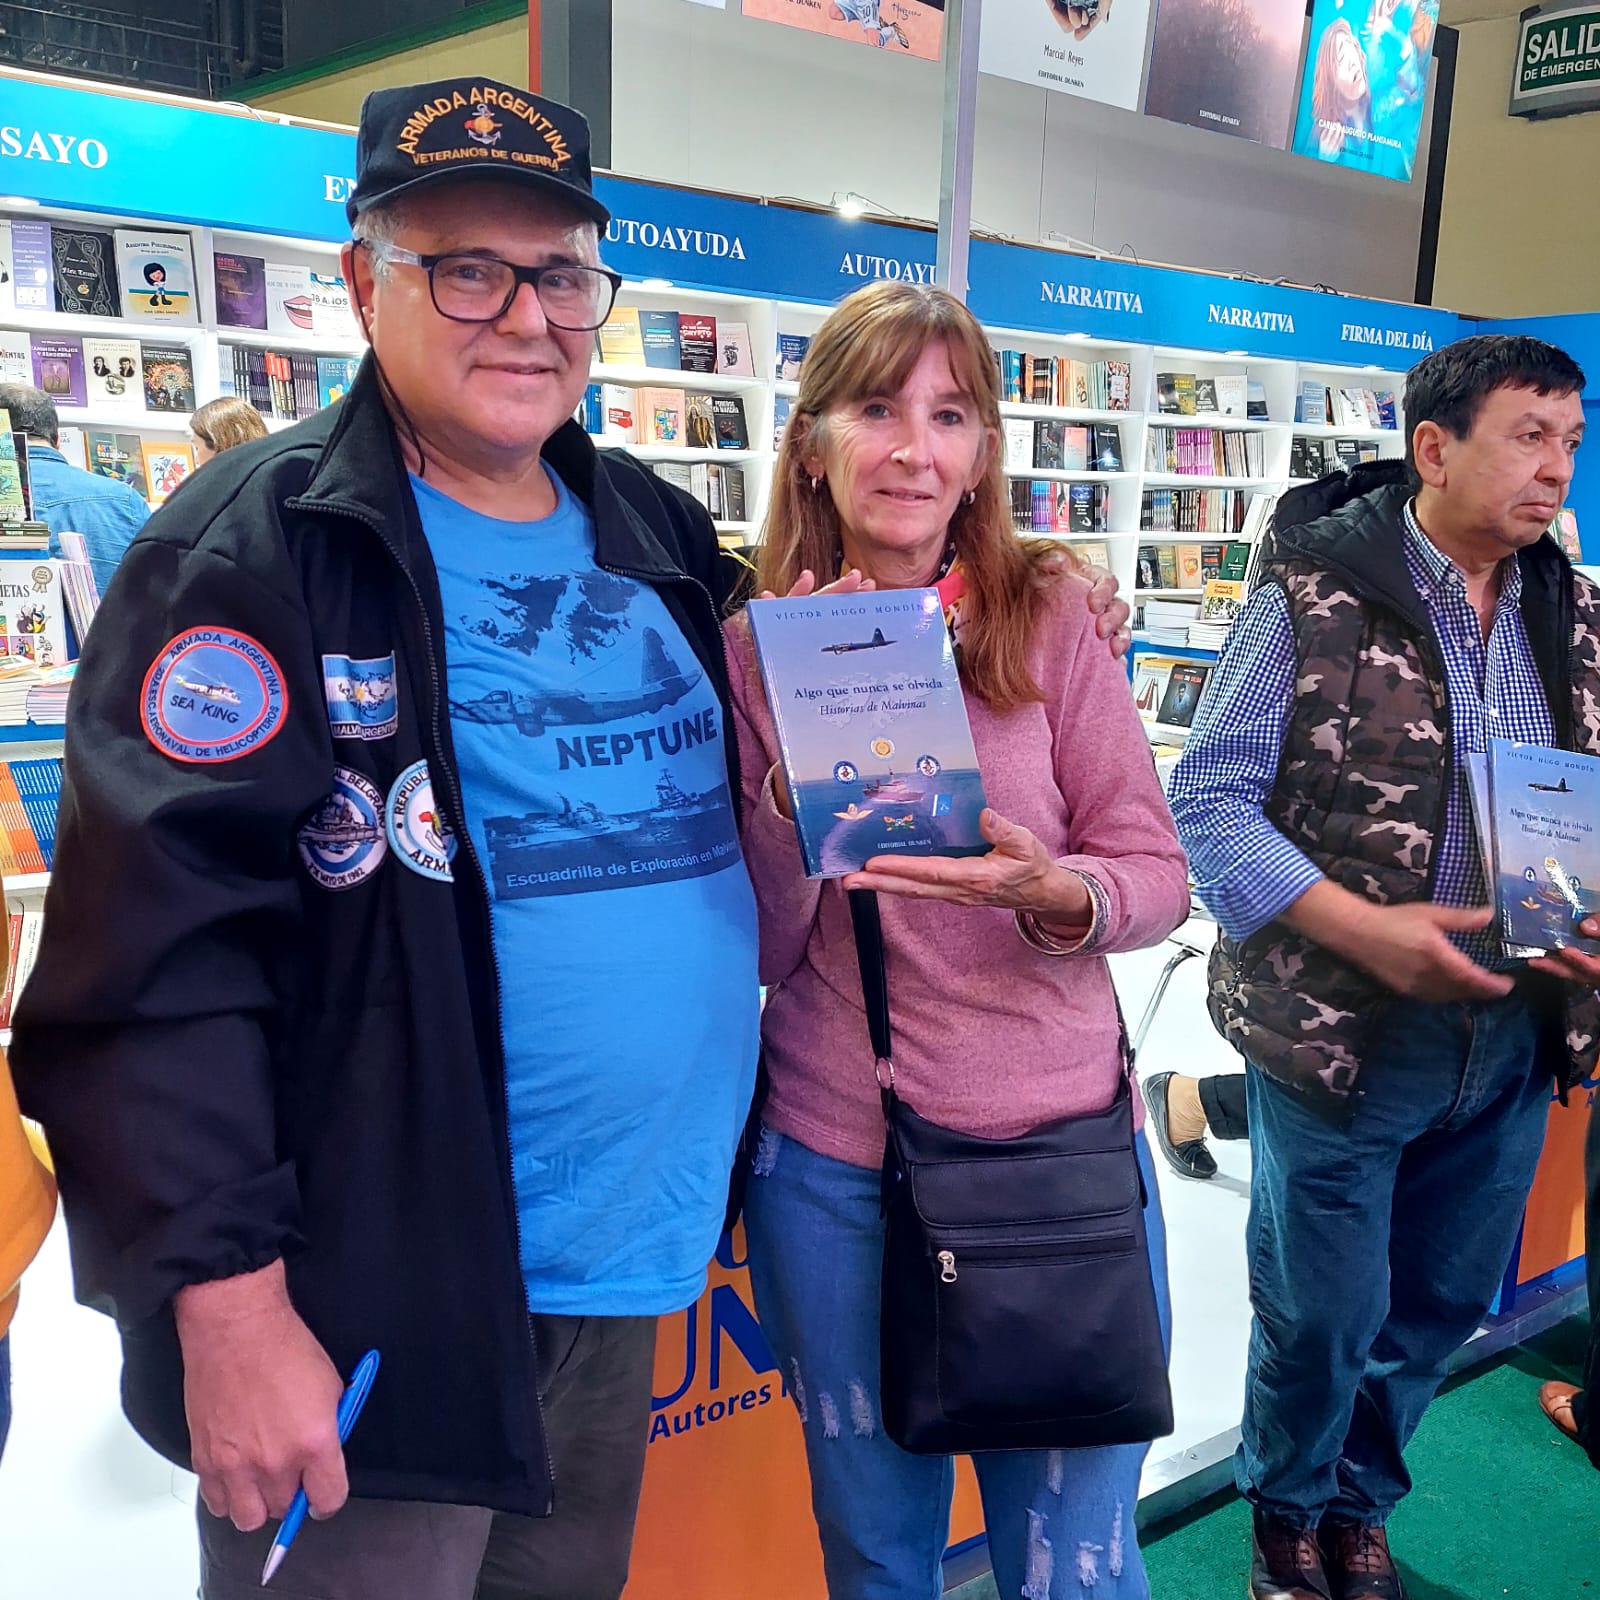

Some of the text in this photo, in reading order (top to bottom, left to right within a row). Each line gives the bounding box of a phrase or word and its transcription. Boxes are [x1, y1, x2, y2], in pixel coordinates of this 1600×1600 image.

[1043, 44, 1084, 67] Marcial Reyes
[1526, 23, 1600, 64] SALID
[1038, 69, 1085, 88] EDITORIAL DUNKEN
[1524, 68, 1538, 81] DE
[397, 87, 572, 164] ARMADA ARGENTINA
[1341, 125, 1366, 138] AUGUSTO
[1367, 132, 1402, 149] PLANTAMURA
[412, 148, 559, 172] VETERANOS DE GUERRA
[605, 218, 746, 260] UTOAYUDA
[839, 252, 936, 286] AUTOAYU
[1040, 281, 1143, 314] NARRATIVA
[1208, 304, 1295, 334] NARRATIVA
[1341, 323, 1433, 352] FIRMA DEL DÍA
[831, 607, 867, 617] HUGO
[169, 632, 280, 696] ARMADA ARGENTINA
[794, 678, 943, 700] Algo que nunca se olvida
[170, 695, 240, 724] SEA KING
[820, 700, 927, 716] Historias de Malvinas
[148, 711, 190, 755] AERONAVAL
[195, 748, 210, 757] DE
[216, 705, 279, 756] HELICOPTEROS
[556, 707, 717, 770] NEPTUNE
[1538, 757, 1560, 766] HUGO
[1509, 807, 1526, 819] Algo
[1526, 813, 1539, 822] que
[1540, 815, 1561, 826] nunca
[408, 849, 451, 874] ARM
[506, 864, 603, 887] Escuadrilla
[608, 862, 627, 876] de
[631, 853, 699, 874] Exploración
[700, 851, 713, 862] en
[648, 1384, 771, 1444] Autores
